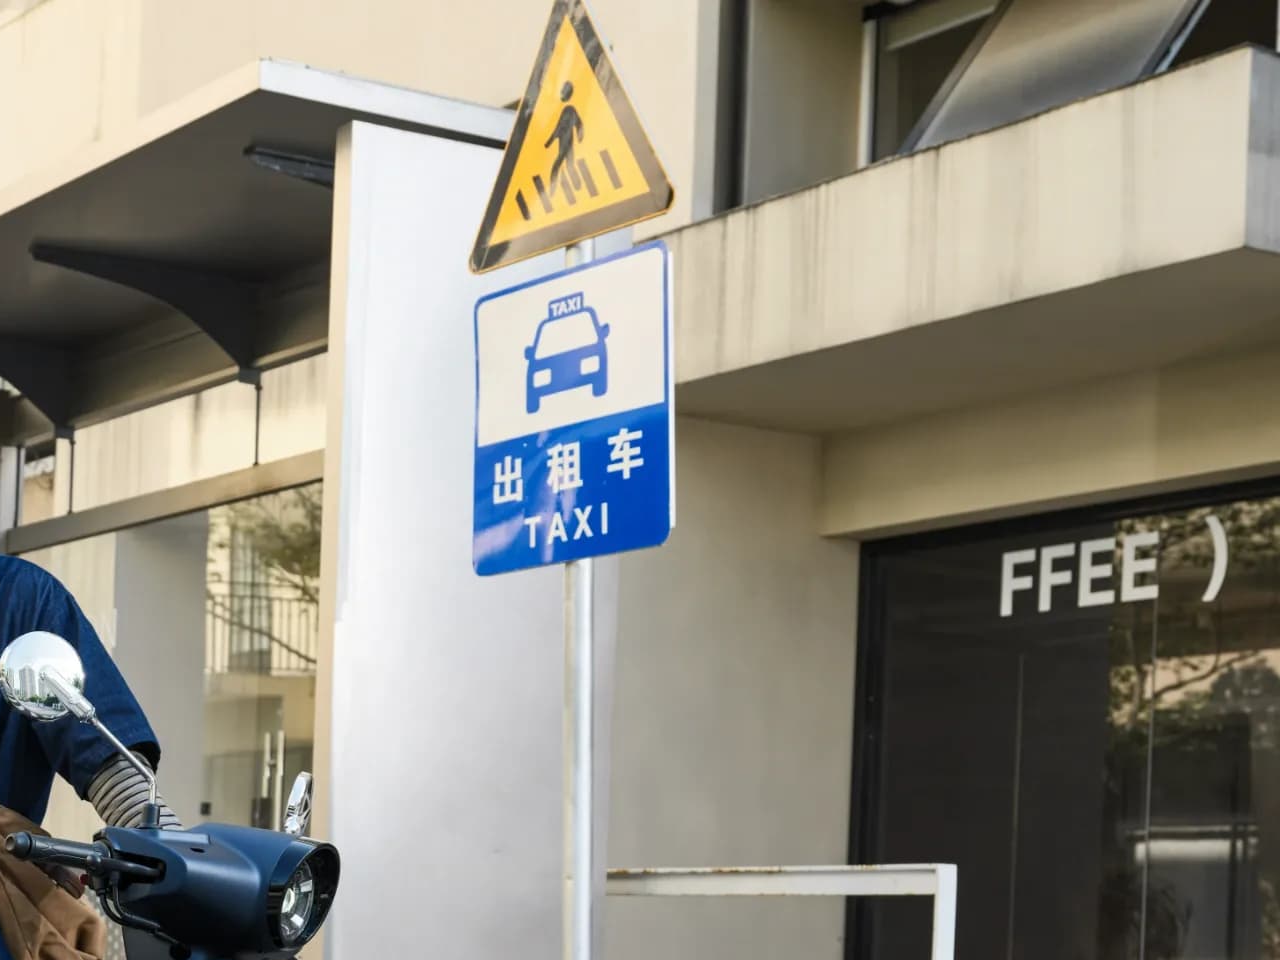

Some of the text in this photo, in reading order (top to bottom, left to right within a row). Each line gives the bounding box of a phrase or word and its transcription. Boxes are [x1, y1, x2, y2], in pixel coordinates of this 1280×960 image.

[550, 295, 581, 317] TAXI
[492, 428, 644, 505] 出租车
[524, 502, 609, 548] TAXI
[999, 531, 1160, 617] FFEE
